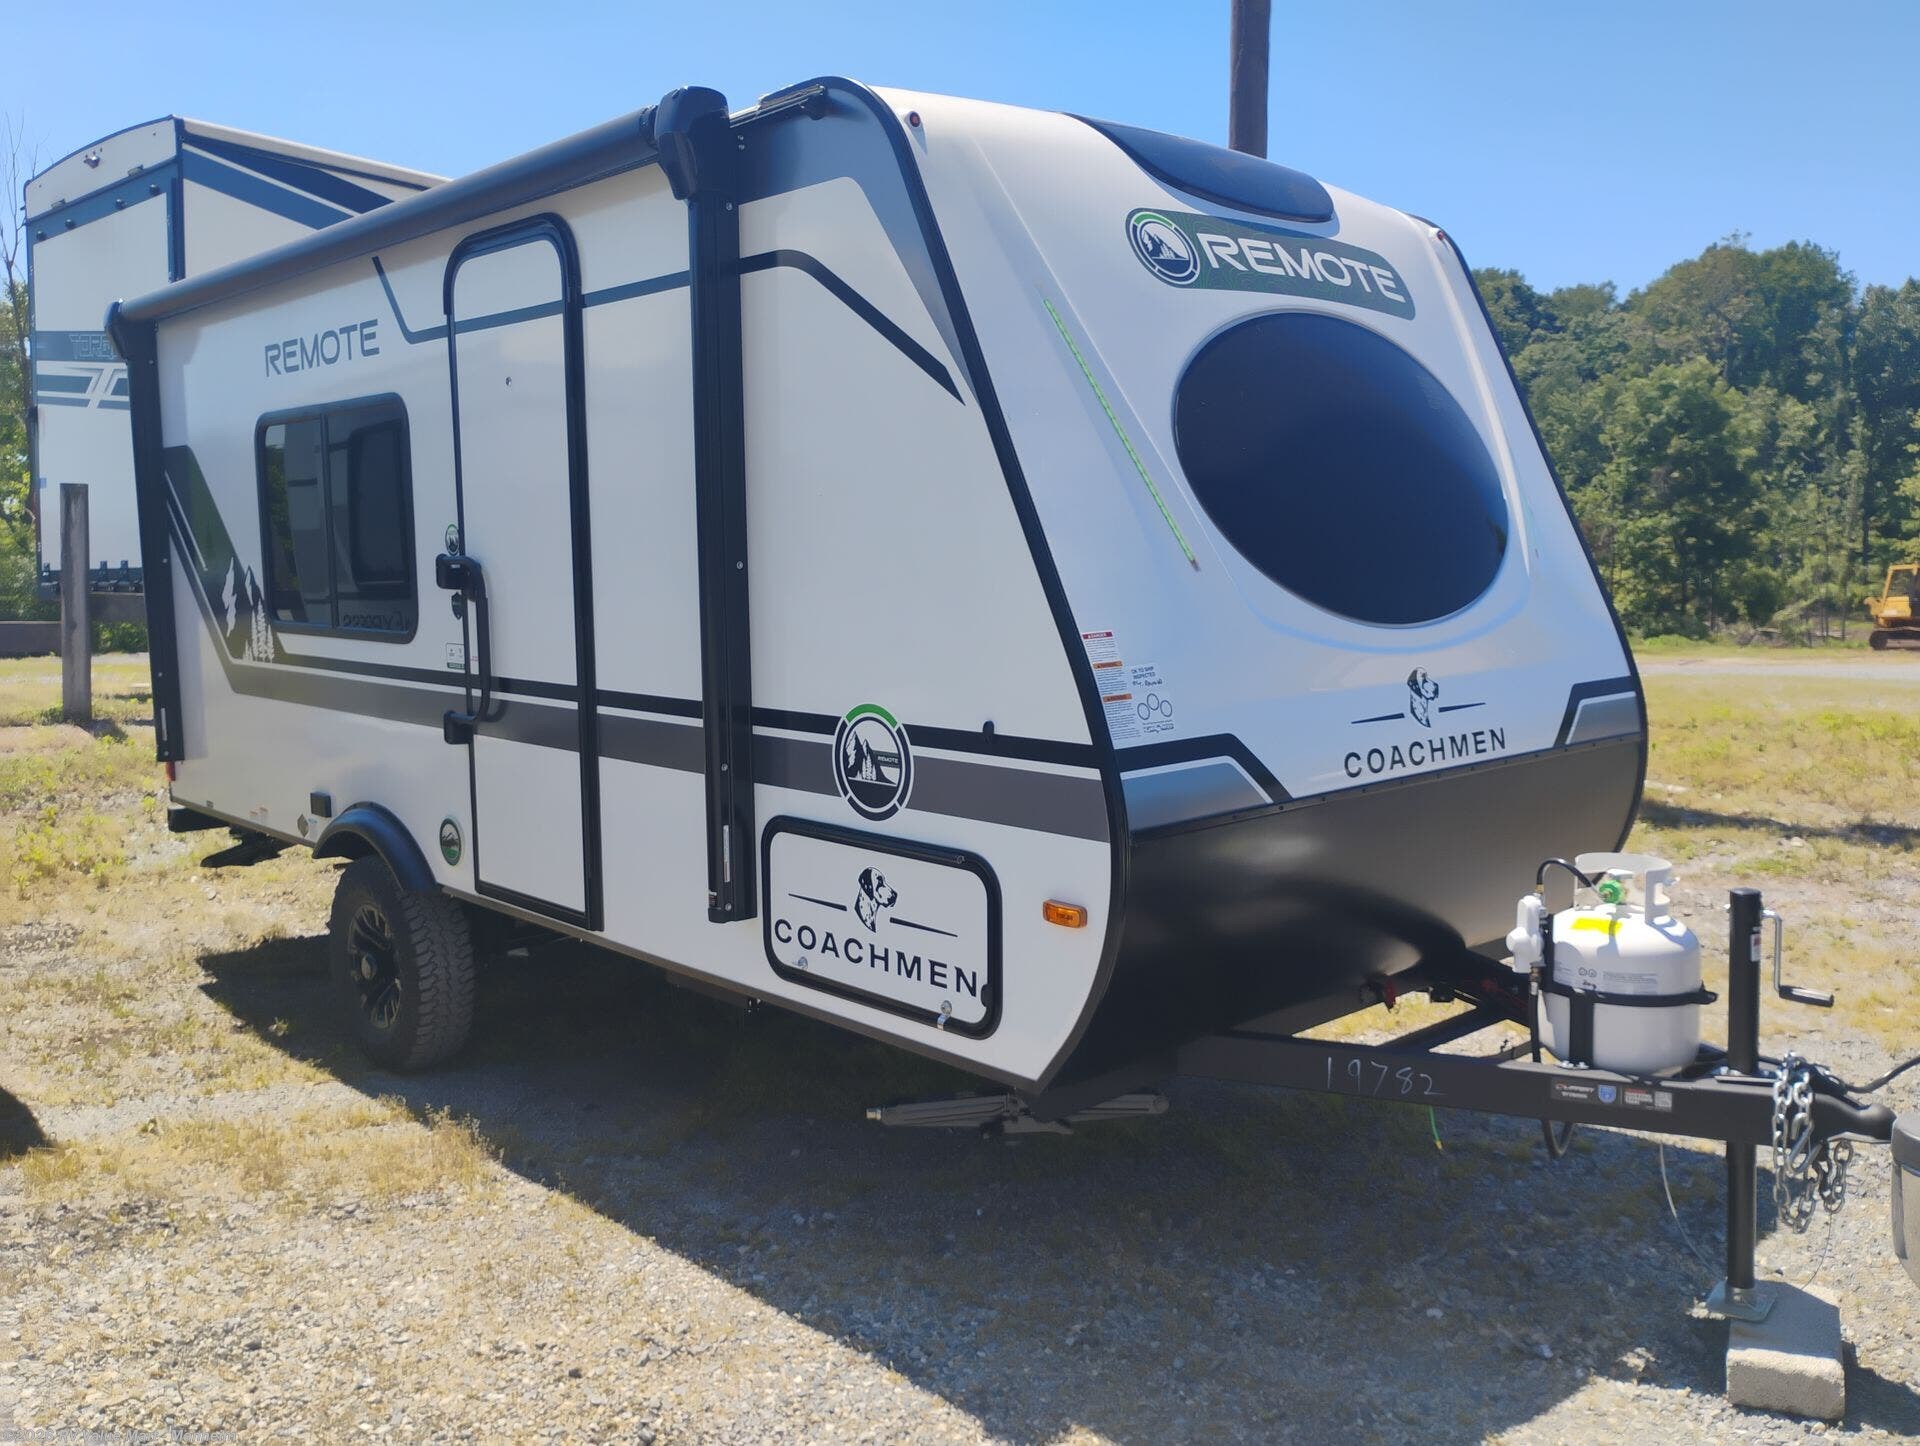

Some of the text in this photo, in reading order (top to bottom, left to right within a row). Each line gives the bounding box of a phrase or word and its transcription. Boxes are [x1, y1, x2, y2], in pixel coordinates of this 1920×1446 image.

[1196, 232, 1406, 303] REMOTE
[265, 319, 380, 378] REMOTE
[877, 755, 899, 764] REMOTE
[1344, 727, 1506, 778] COACHMEN
[774, 918, 978, 998] COACHMEN
[1327, 1057, 1448, 1097] 19782
